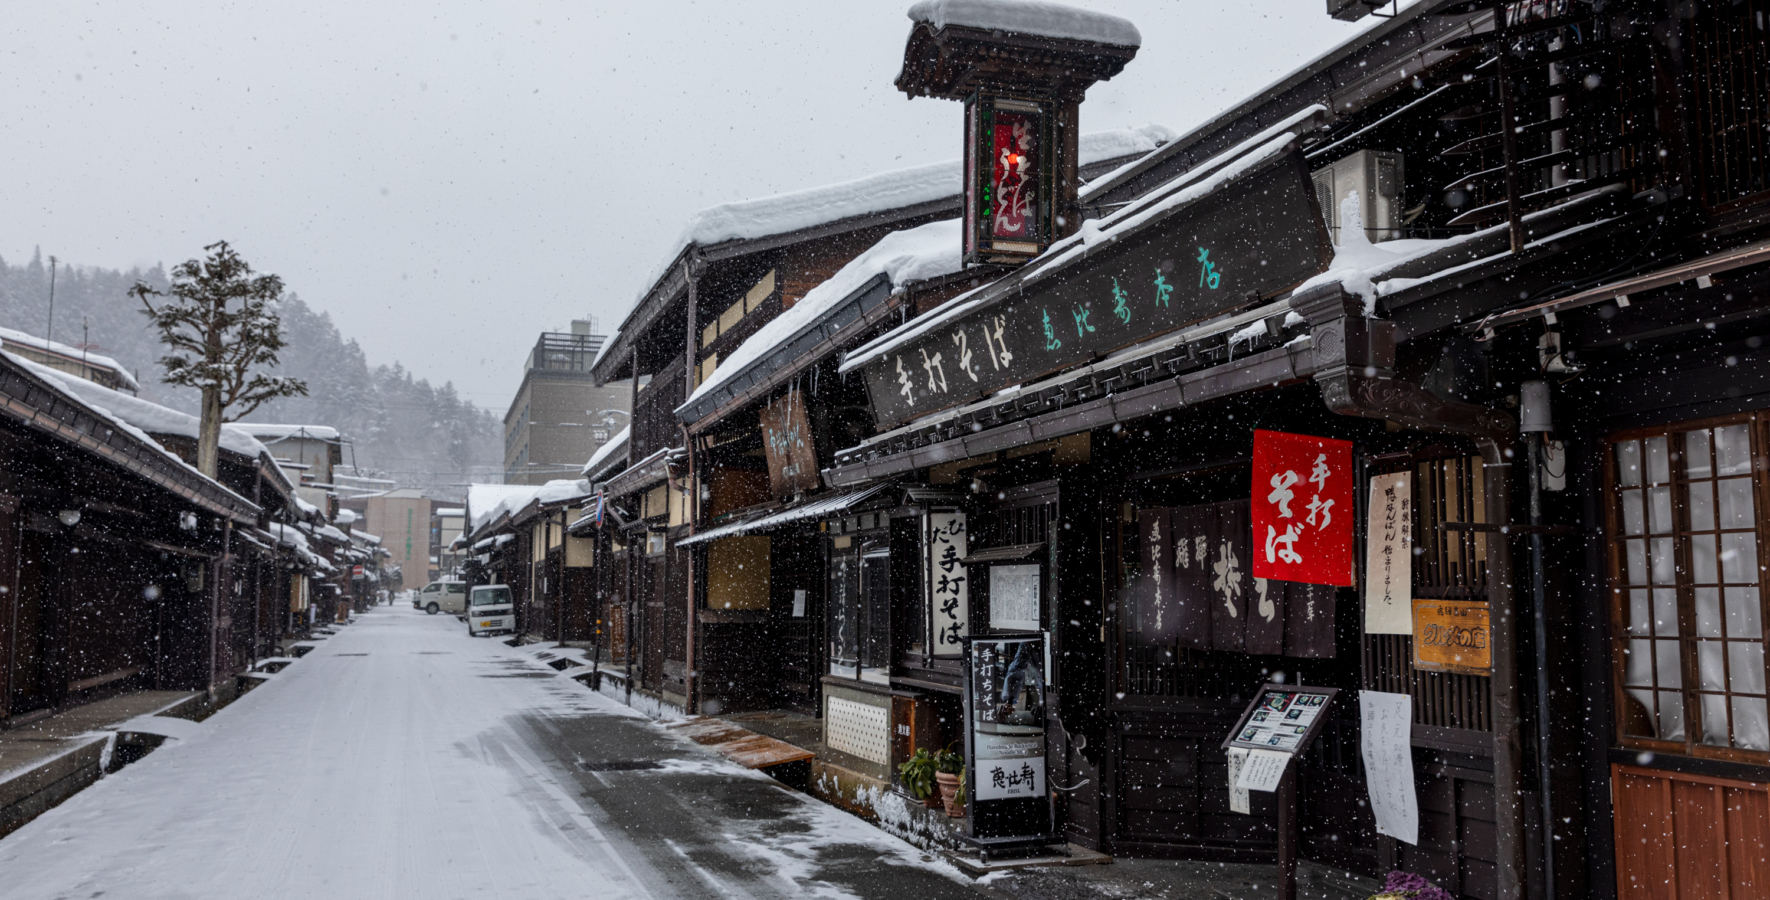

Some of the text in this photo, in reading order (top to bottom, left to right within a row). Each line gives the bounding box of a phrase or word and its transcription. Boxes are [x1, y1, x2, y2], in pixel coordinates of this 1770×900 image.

[896, 313, 1013, 407] 手打そば
[1265, 470, 1305, 564] そば
[1305, 453, 1335, 532] 手打
[1424, 624, 1486, 649] グルメの店
[980, 648, 995, 721] 手打ちそば
